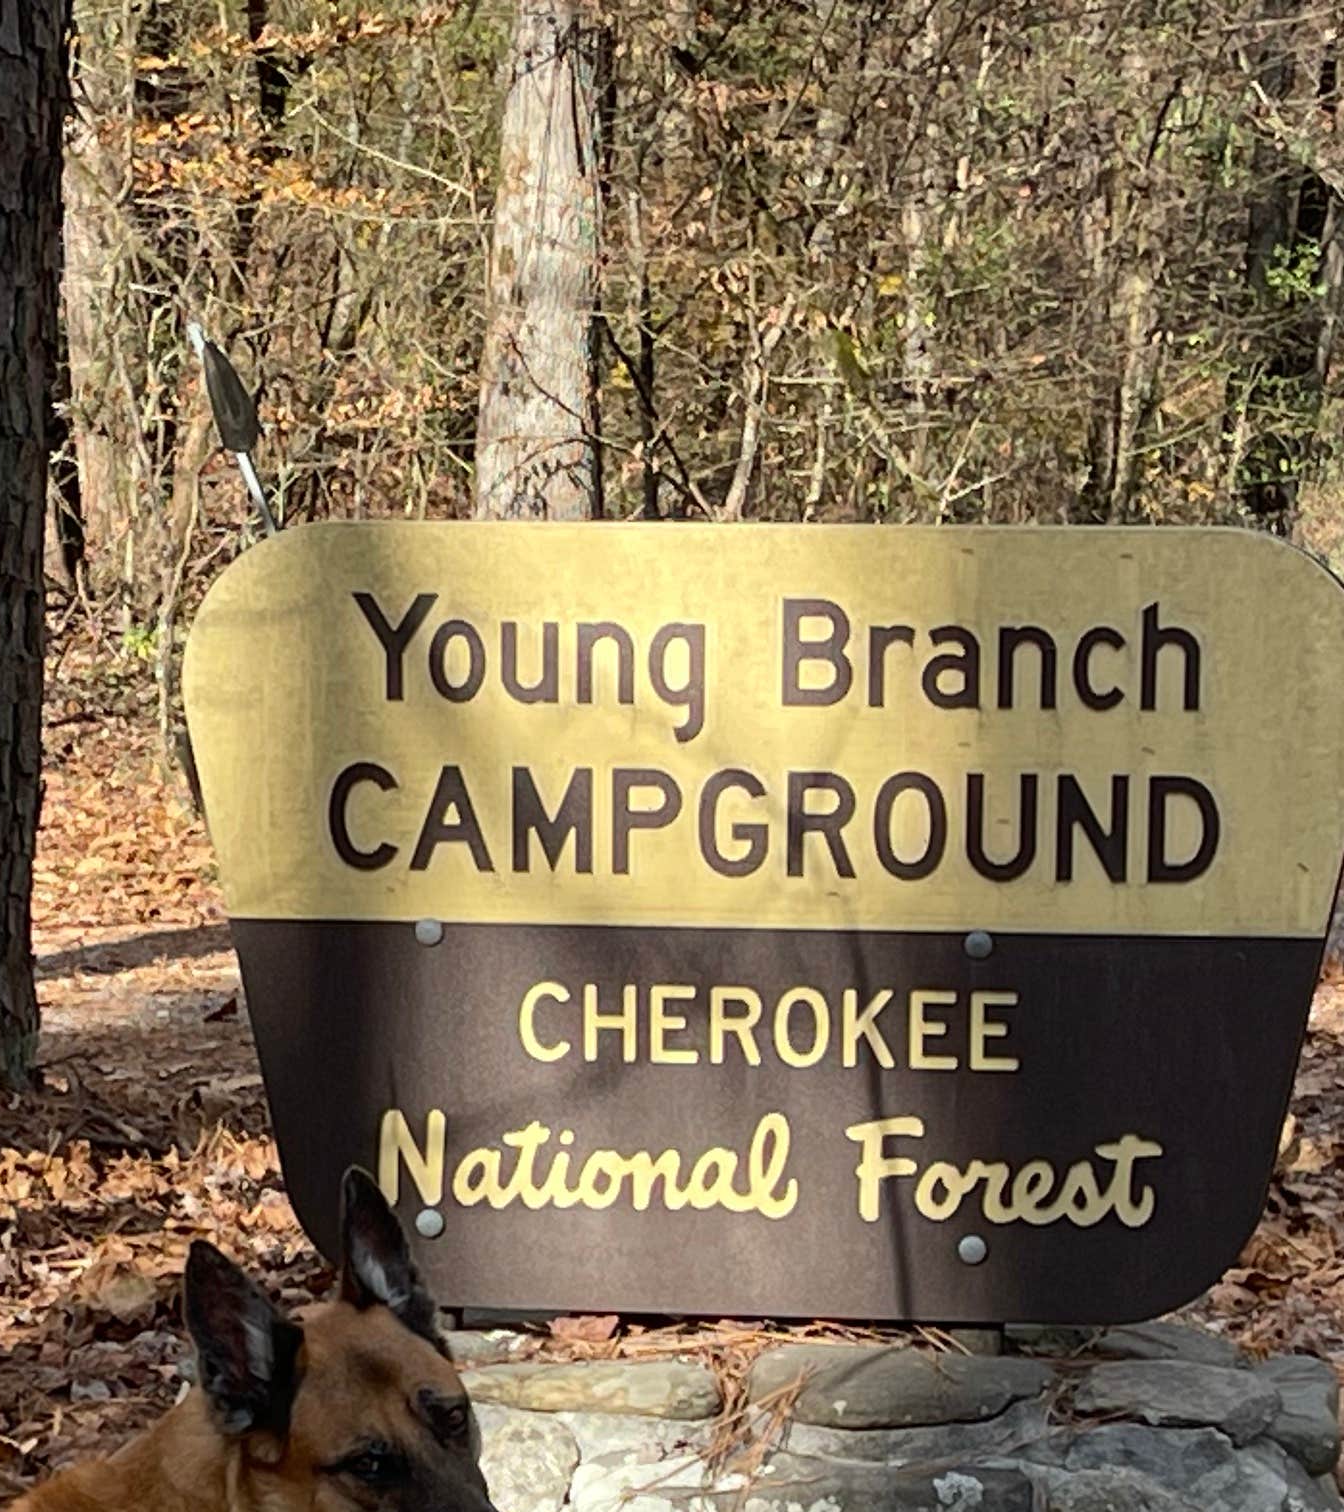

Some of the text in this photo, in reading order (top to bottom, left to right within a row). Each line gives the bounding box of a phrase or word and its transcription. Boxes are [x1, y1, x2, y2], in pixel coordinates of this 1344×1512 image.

[352, 592, 1201, 744] Young Branch
[327, 761, 1221, 885] CAMPGROUND
[519, 981, 1020, 1072] CHEROKEE
[377, 1108, 1164, 1229] National Forest
